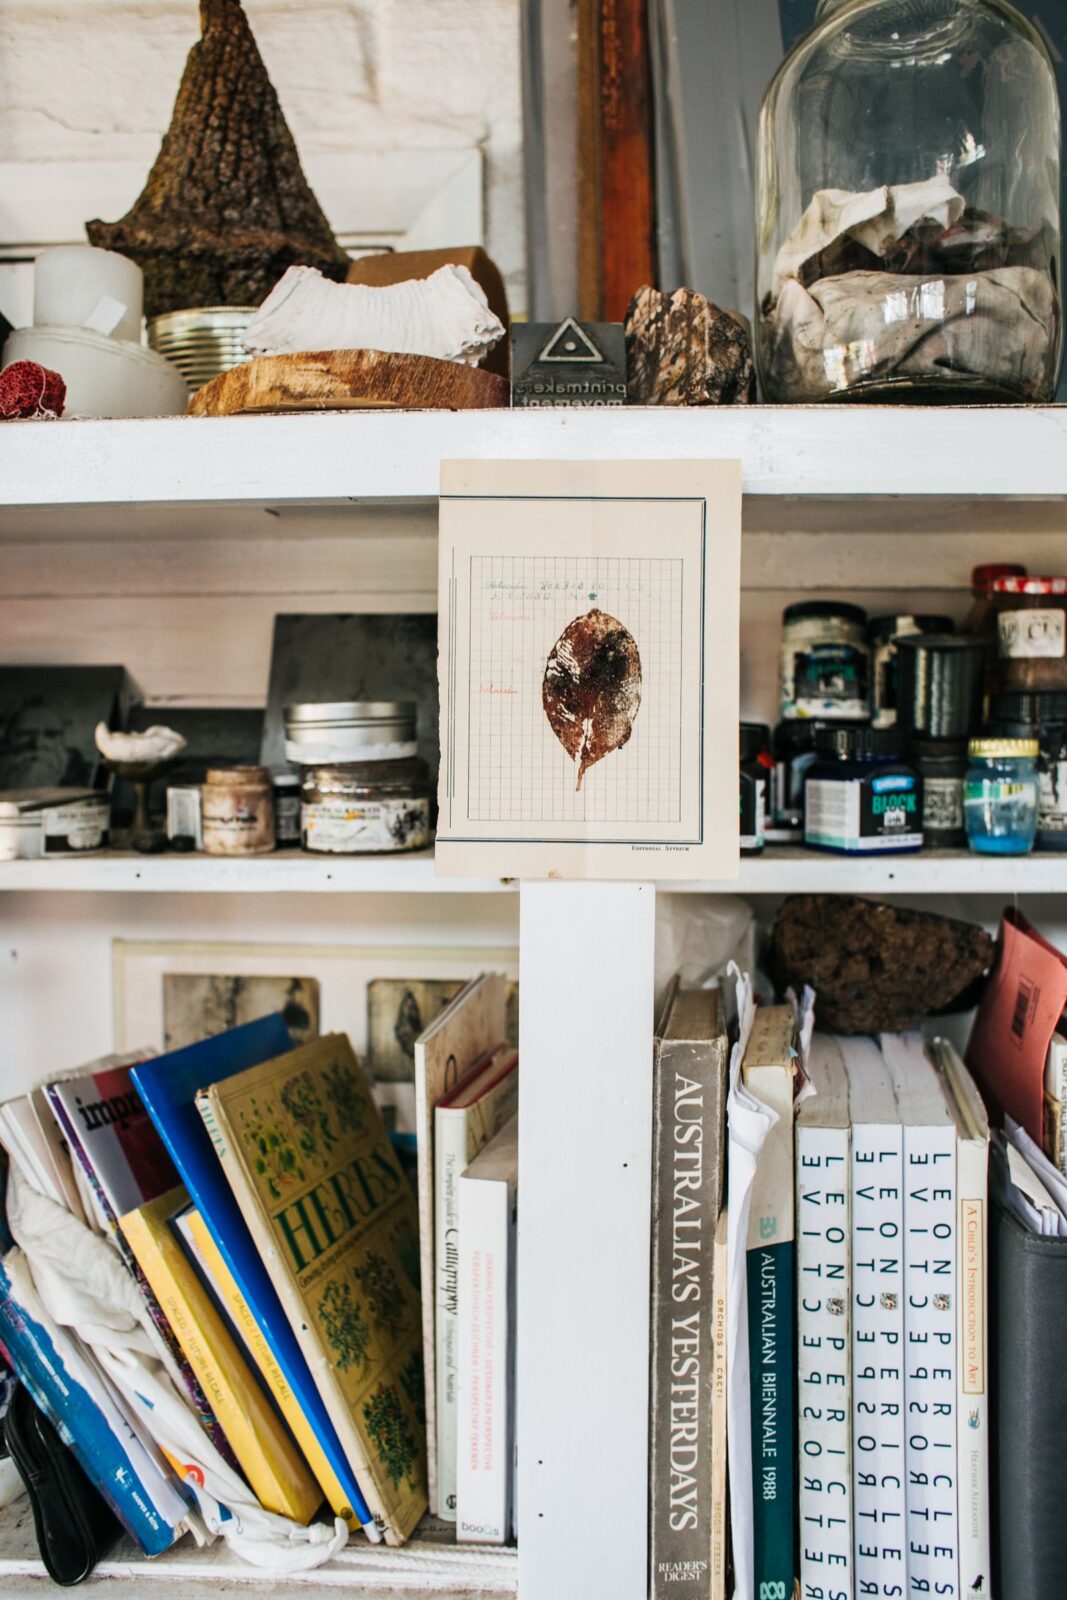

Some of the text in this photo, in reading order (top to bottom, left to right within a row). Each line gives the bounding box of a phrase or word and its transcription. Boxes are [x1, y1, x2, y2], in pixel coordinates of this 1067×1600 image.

[871, 794, 916, 815] BLOCK
[274, 1149, 403, 1274] HERBS
[967, 1207, 978, 1216] A
[166, 1296, 188, 1330] SPACED
[187, 1337, 208, 1371] FUTURE
[204, 1371, 226, 1405] RECALL
[233, 1293, 256, 1327] SPACED
[253, 1334, 275, 1368] FUTURE
[270, 1368, 292, 1401] RECALL
[484, 1293, 494, 1349] PERSPECTIVE
[668, 1073, 703, 1531] AUSTRALIA'S YESTERDAYS
[716, 1298, 724, 1348] ORCHIDS
[761, 1253, 778, 1500] AUSTRALIAN BIENNALE 1988
[826, 1156, 848, 1600] LEON PERICLES
[879, 1151, 901, 1597] LEON PERICLES
[933, 1152, 954, 1595] LEON PERICLES
[484, 1416, 494, 1471] PERSPECTIVE
[658, 1560, 708, 1572] READER'S
[664, 1571, 702, 1582] DIGEST
